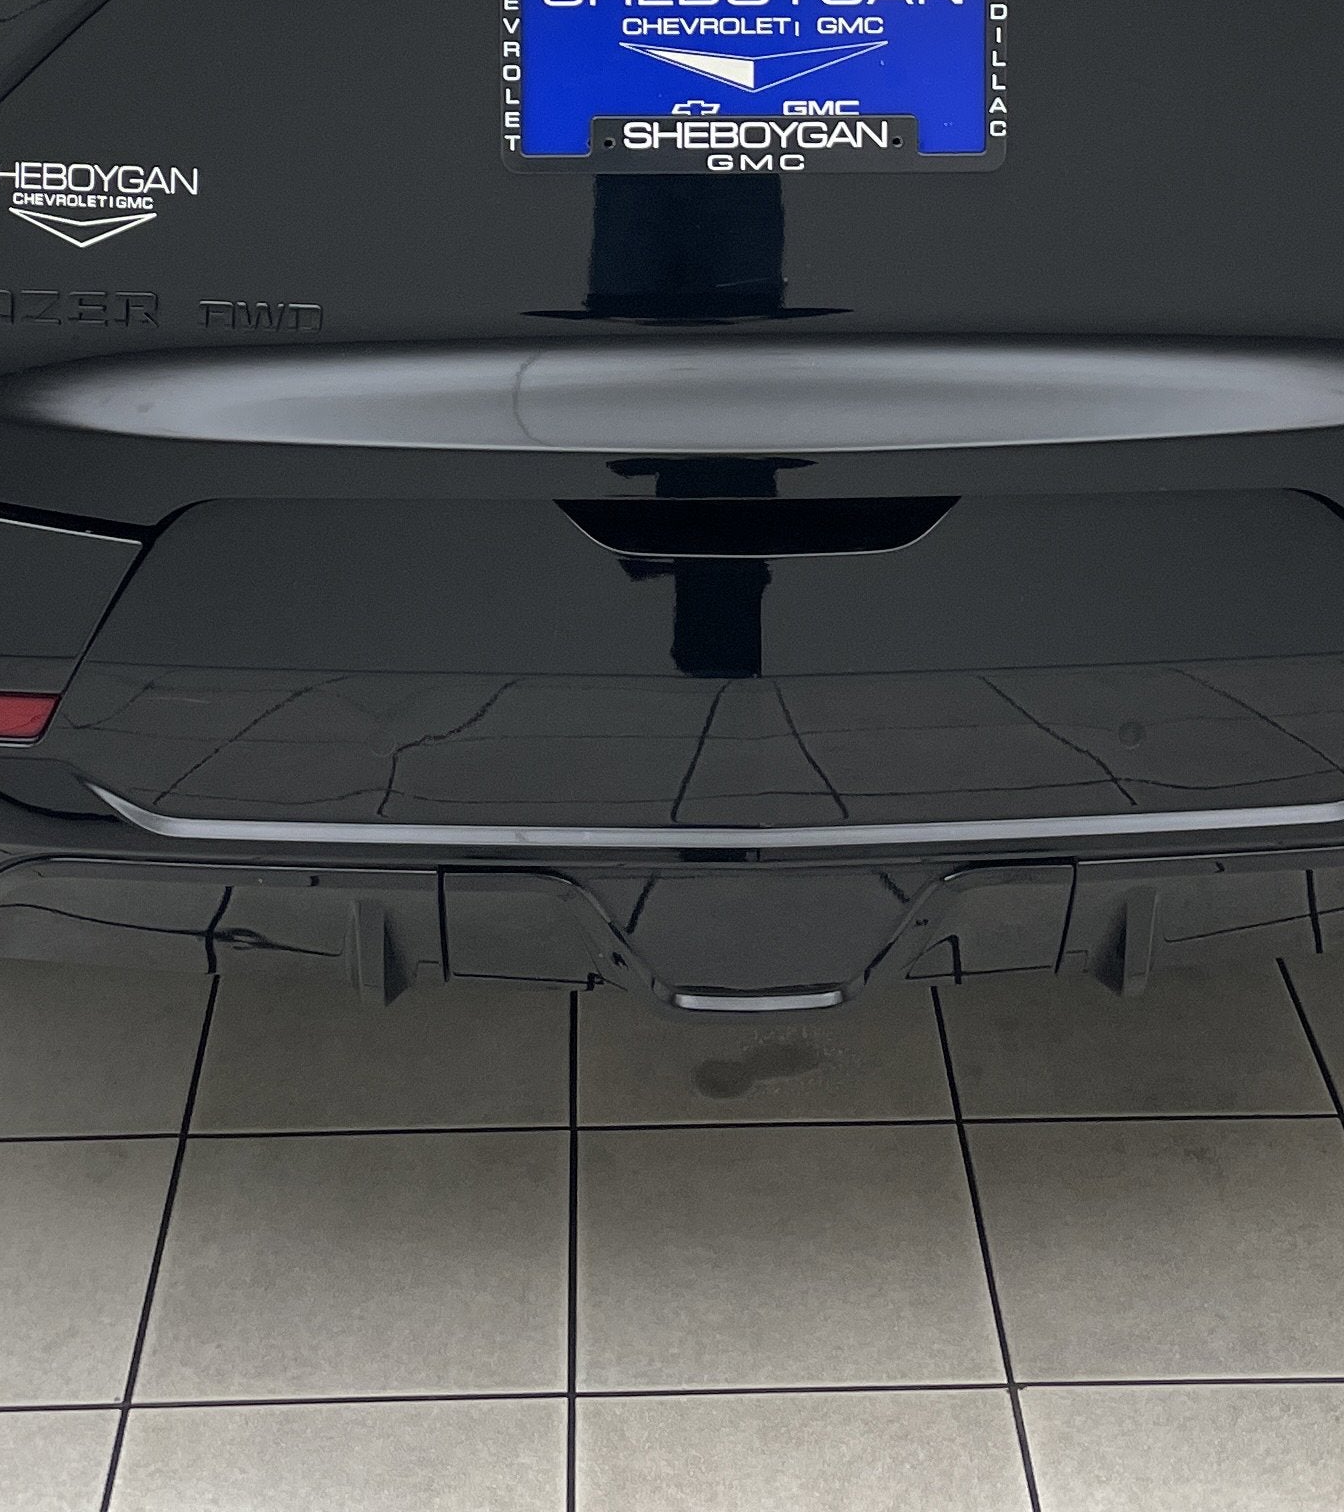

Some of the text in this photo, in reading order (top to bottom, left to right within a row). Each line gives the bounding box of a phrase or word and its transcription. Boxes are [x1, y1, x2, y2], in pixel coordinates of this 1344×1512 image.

[622, 16, 884, 36] CHEVROLET GMC
[782, 100, 860, 116] GMC
[623, 121, 888, 150] SHEBOYGAN
[707, 154, 805, 171] GMC
[199, 299, 324, 334] AWD
